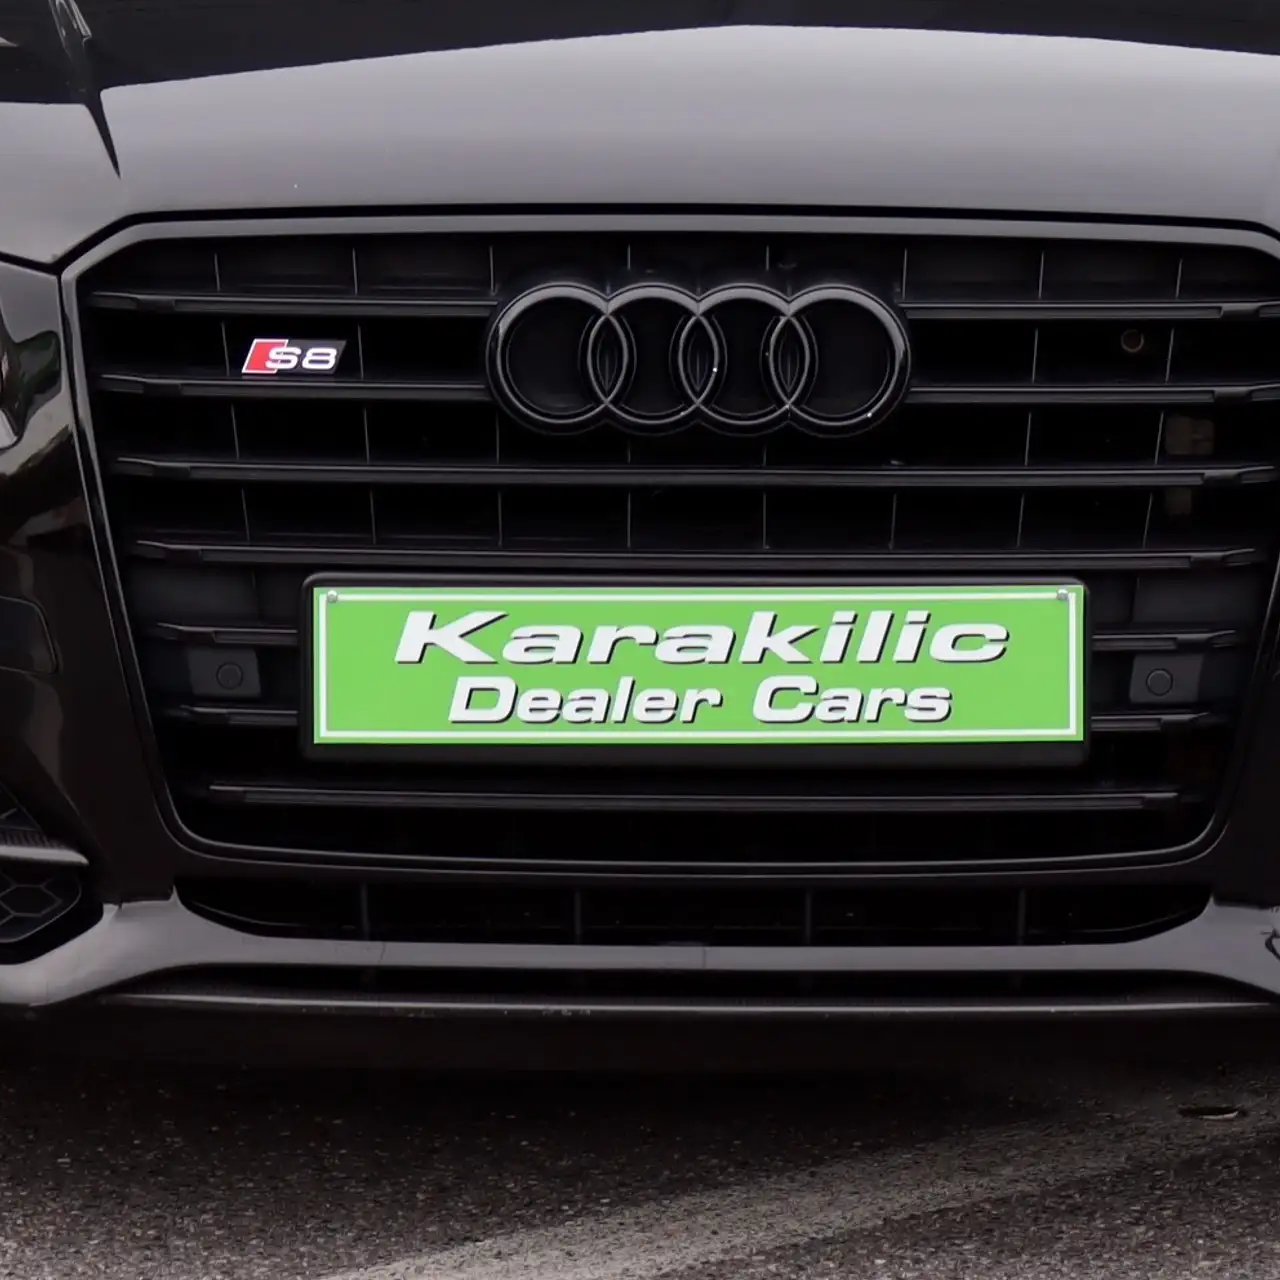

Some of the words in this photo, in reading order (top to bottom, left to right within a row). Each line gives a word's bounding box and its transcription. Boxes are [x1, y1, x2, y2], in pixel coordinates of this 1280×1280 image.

[265, 346, 338, 370] S8
[394, 610, 1010, 665] Karakilic
[448, 676, 724, 724] Dealer
[752, 674, 953, 724] Cars
